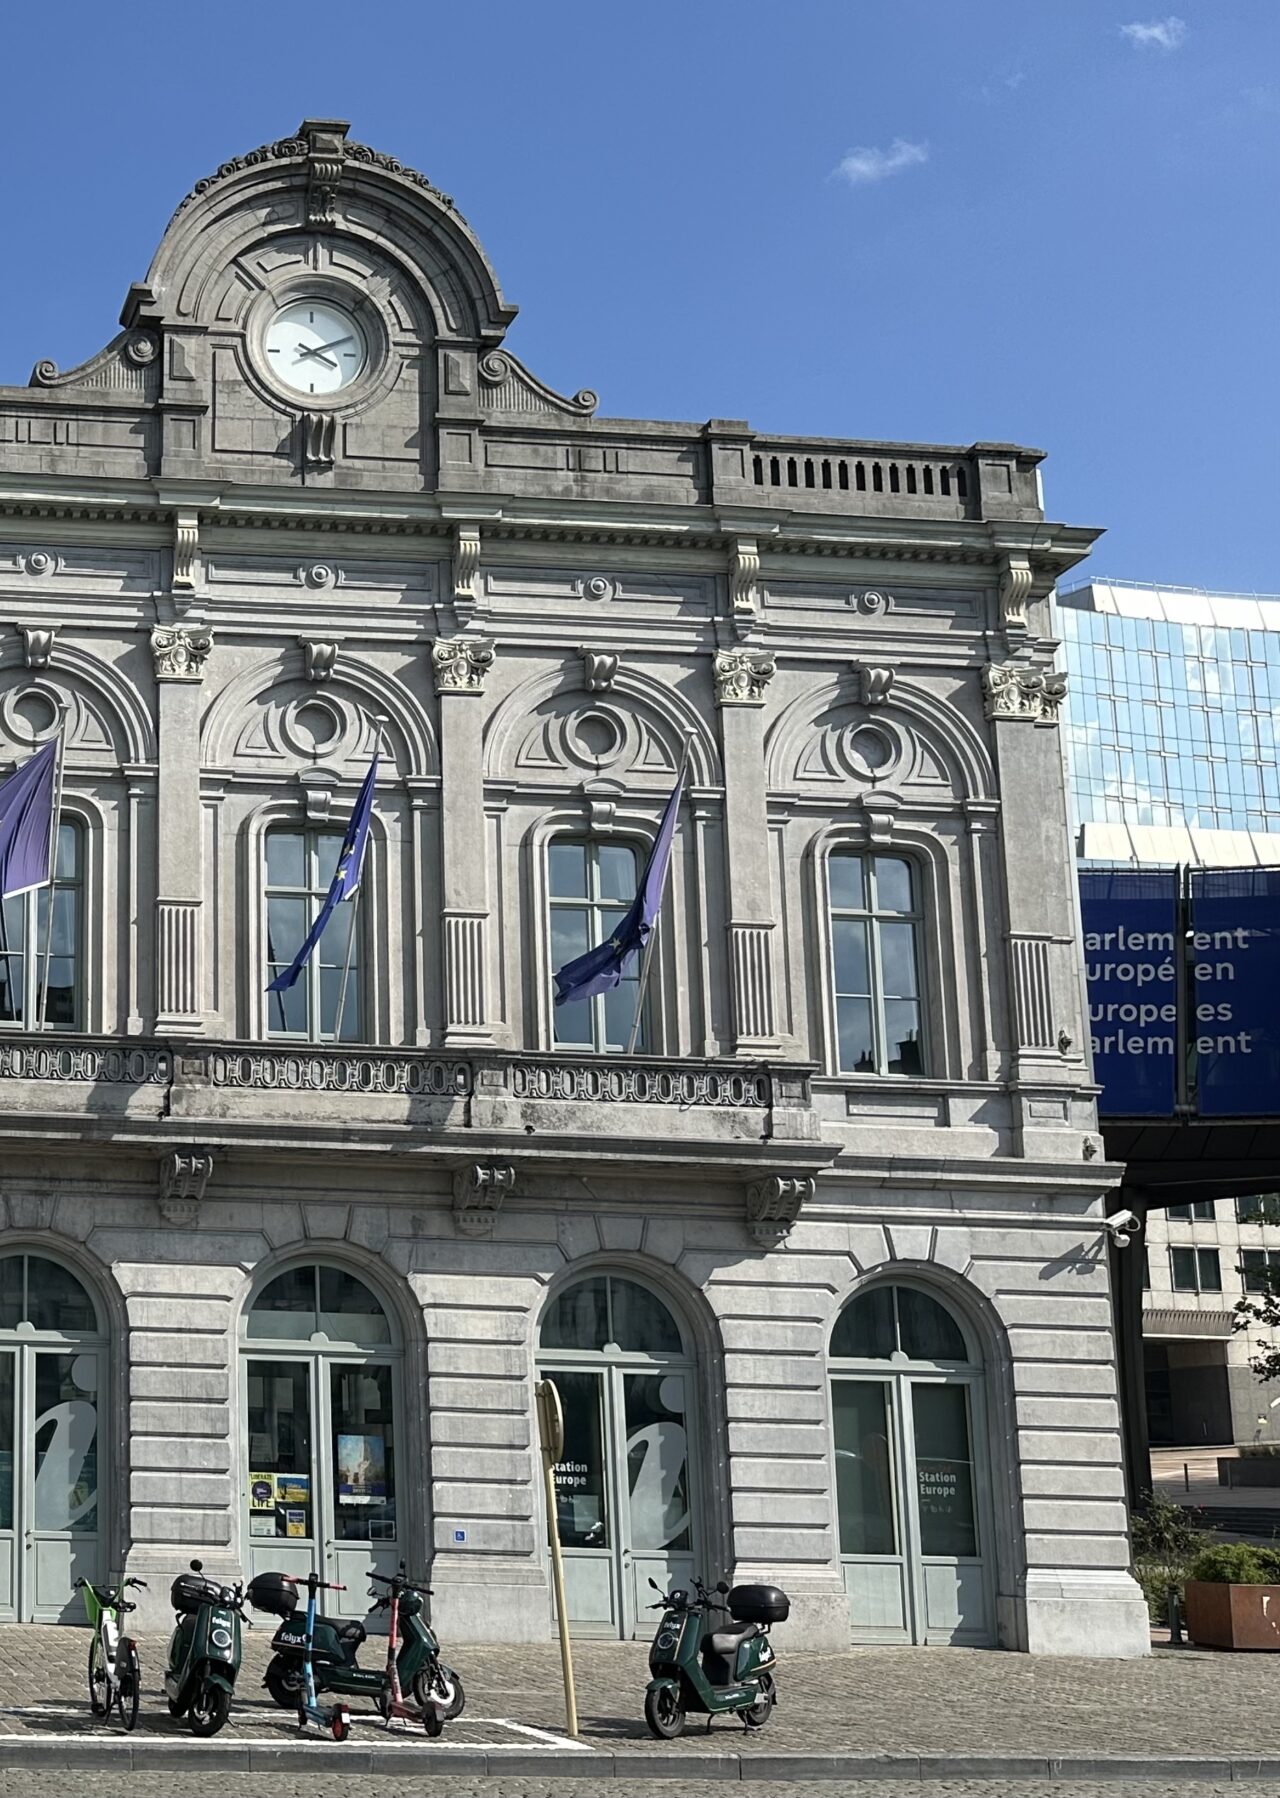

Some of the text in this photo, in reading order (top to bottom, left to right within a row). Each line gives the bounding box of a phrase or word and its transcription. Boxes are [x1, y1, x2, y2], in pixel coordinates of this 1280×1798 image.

[1085, 925, 1249, 951] arlement
[1085, 957, 1235, 986] uropéen
[1088, 1002, 1233, 1027] uropees
[1090, 1029, 1252, 1055] arlement
[553, 1474, 587, 1487] urope
[919, 1471, 957, 1483] Station
[920, 1484, 956, 1498] Europe
[281, 1632, 302, 1645] felyx
